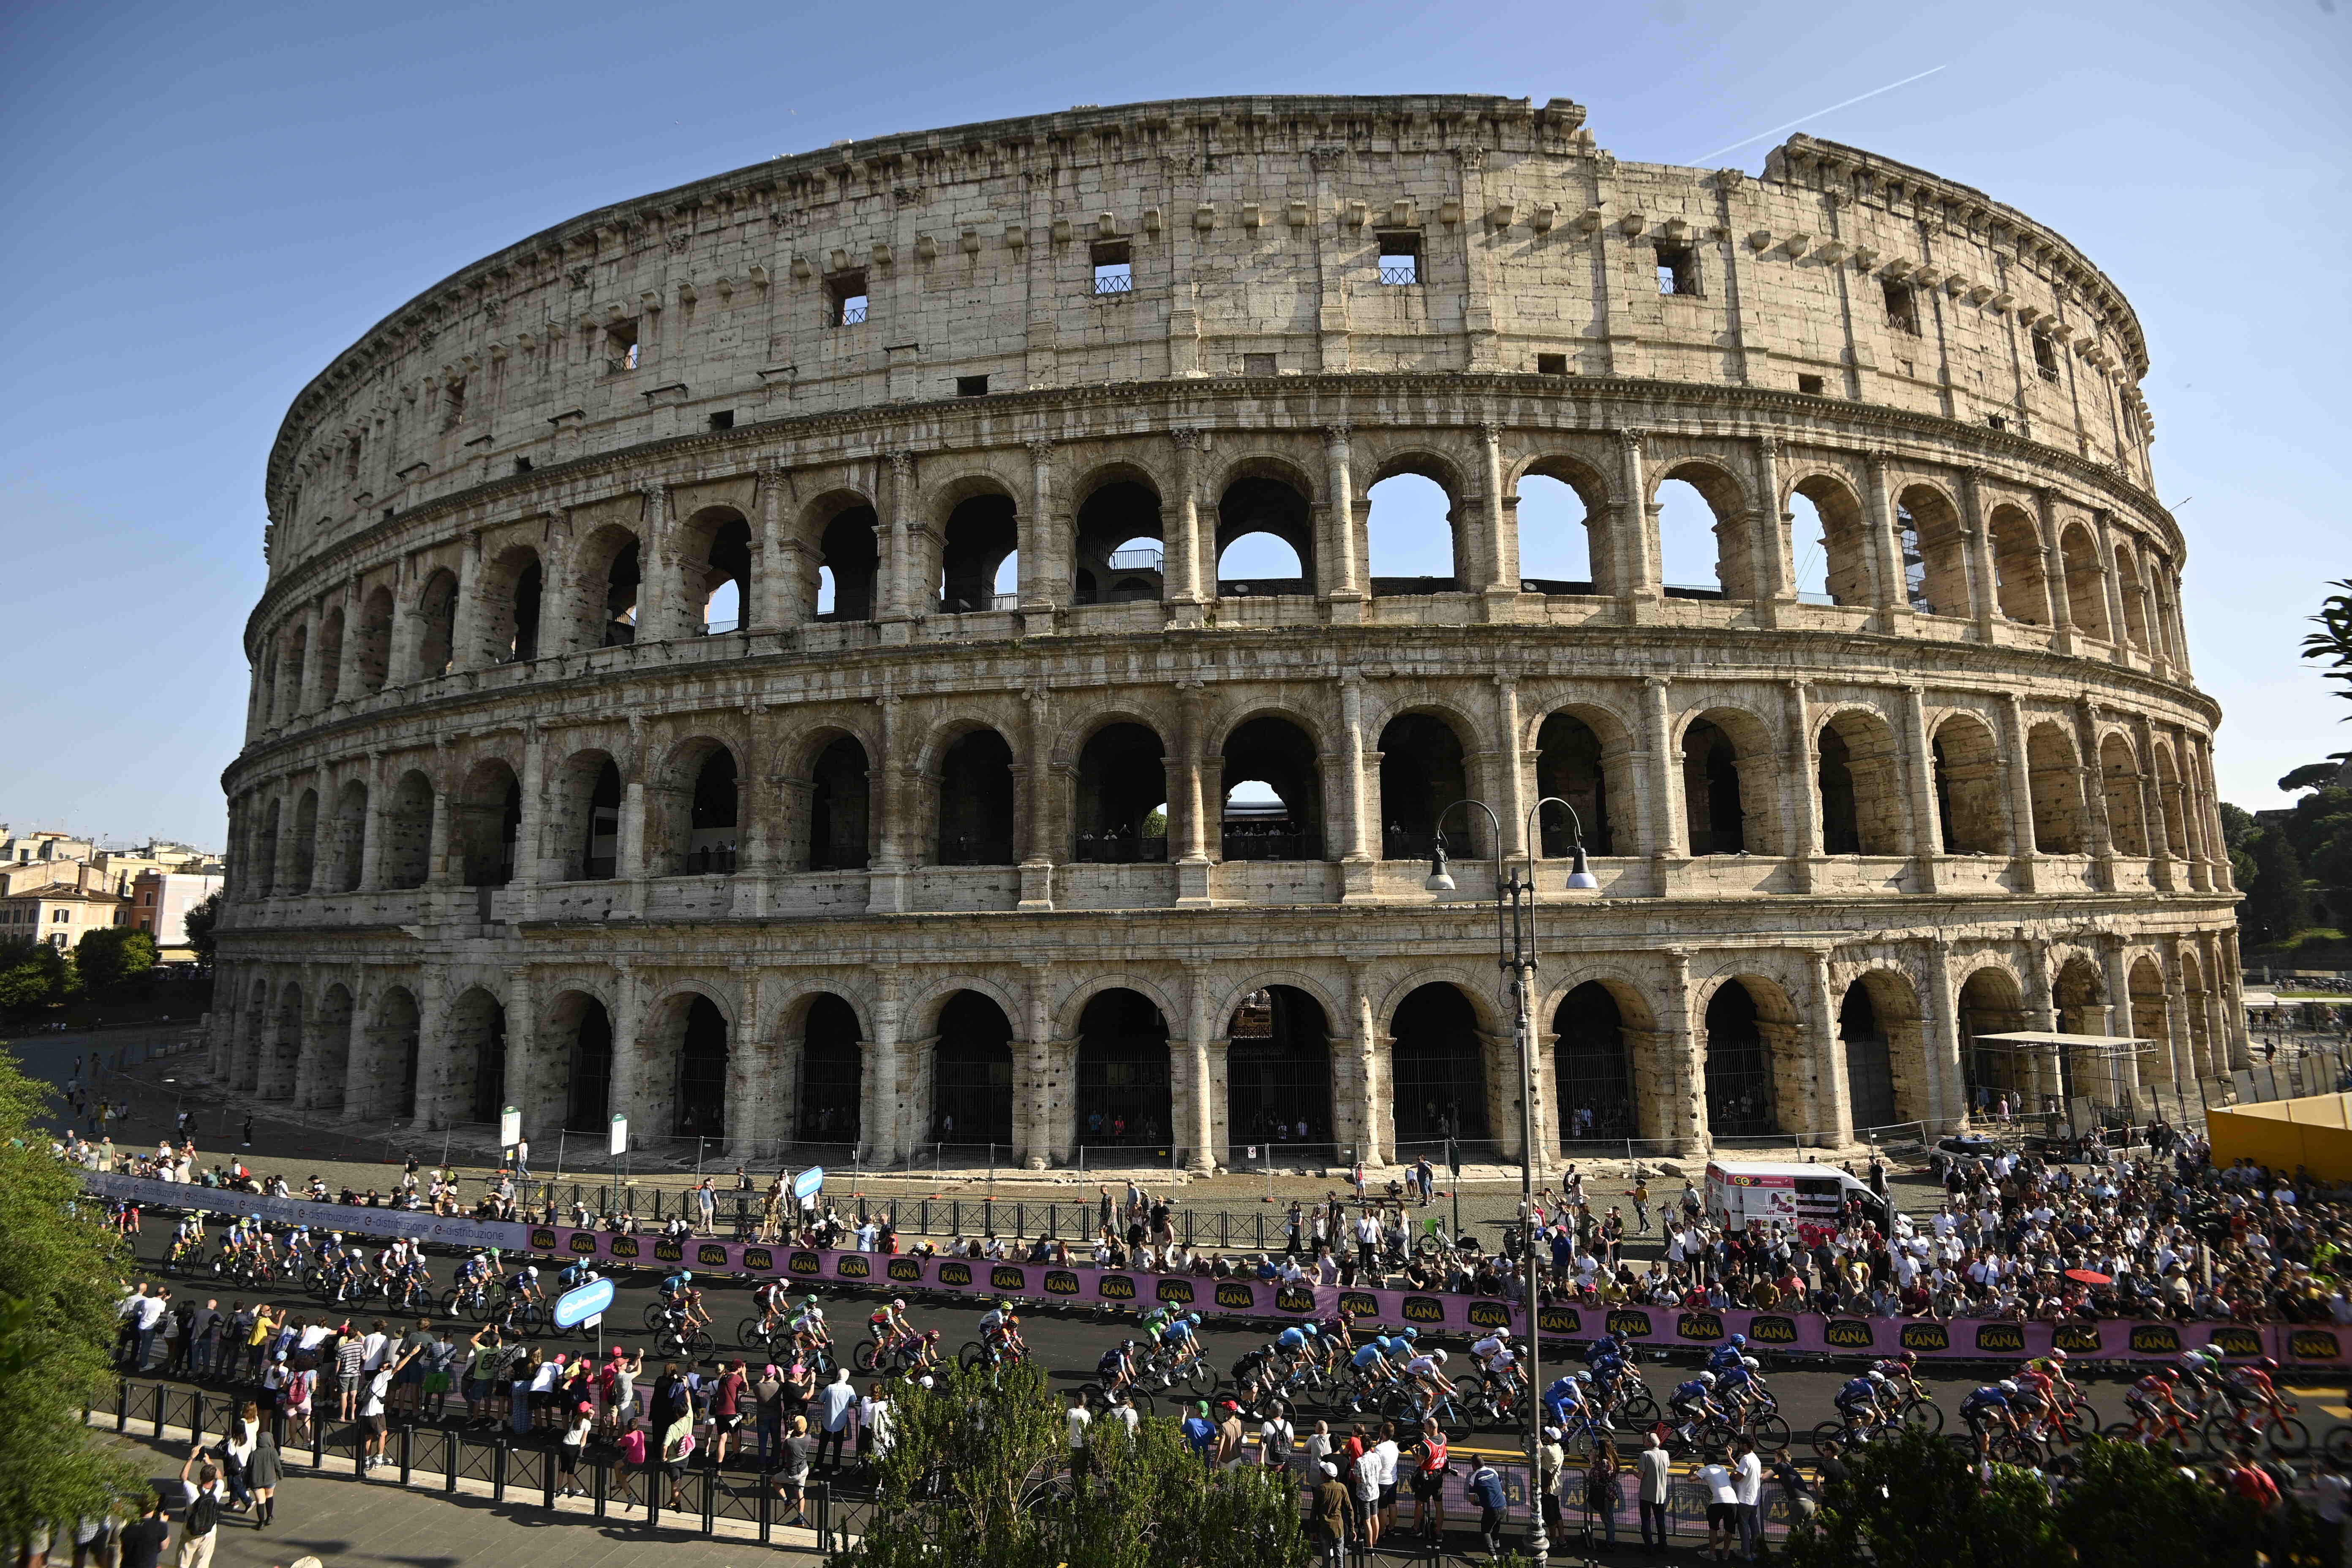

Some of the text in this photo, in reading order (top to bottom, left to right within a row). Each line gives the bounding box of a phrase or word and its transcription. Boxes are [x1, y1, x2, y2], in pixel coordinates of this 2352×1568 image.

[239, 1199, 294, 1217] e-distribuzione
[298, 1209, 359, 1225] e-distribuzione
[365, 1216, 429, 1233] e-distribuzione
[435, 1224, 504, 1241] e-distribuzione
[533, 1236, 555, 1247] RANA
[572, 1240, 594, 1251] RANA
[614, 1244, 637, 1255] RANA
[657, 1250, 681, 1259] RANA
[700, 1252, 725, 1263] RANA
[746, 1255, 770, 1267] RANA
[792, 1260, 817, 1272] RANA
[841, 1263, 868, 1275] RANA
[891, 1267, 918, 1279] RANA
[942, 1270, 969, 1282] RANA
[994, 1274, 1021, 1287] RANA
[1047, 1279, 1077, 1292] RANA
[1102, 1284, 1134, 1297] RANA
[1160, 1288, 1192, 1301] RANA
[1218, 1292, 1251, 1306] RANA
[1279, 1296, 1312, 1309] RANA
[1340, 1301, 1376, 1315] RANA
[1405, 1305, 1440, 1319] RANA
[1473, 1311, 1508, 1325] RANA
[1540, 1316, 1577, 1329] RANA
[1610, 1320, 1648, 1333] RANA
[1681, 1323, 1721, 1337] RANA
[1753, 1326, 1794, 1339] RANA
[1829, 1330, 1868, 1344] RANA
[1905, 1334, 1946, 1346] RANA
[1981, 1335, 2021, 1348] RANA
[2056, 1336, 2097, 1348] RANA
[2133, 1337, 2176, 1349] RANA
